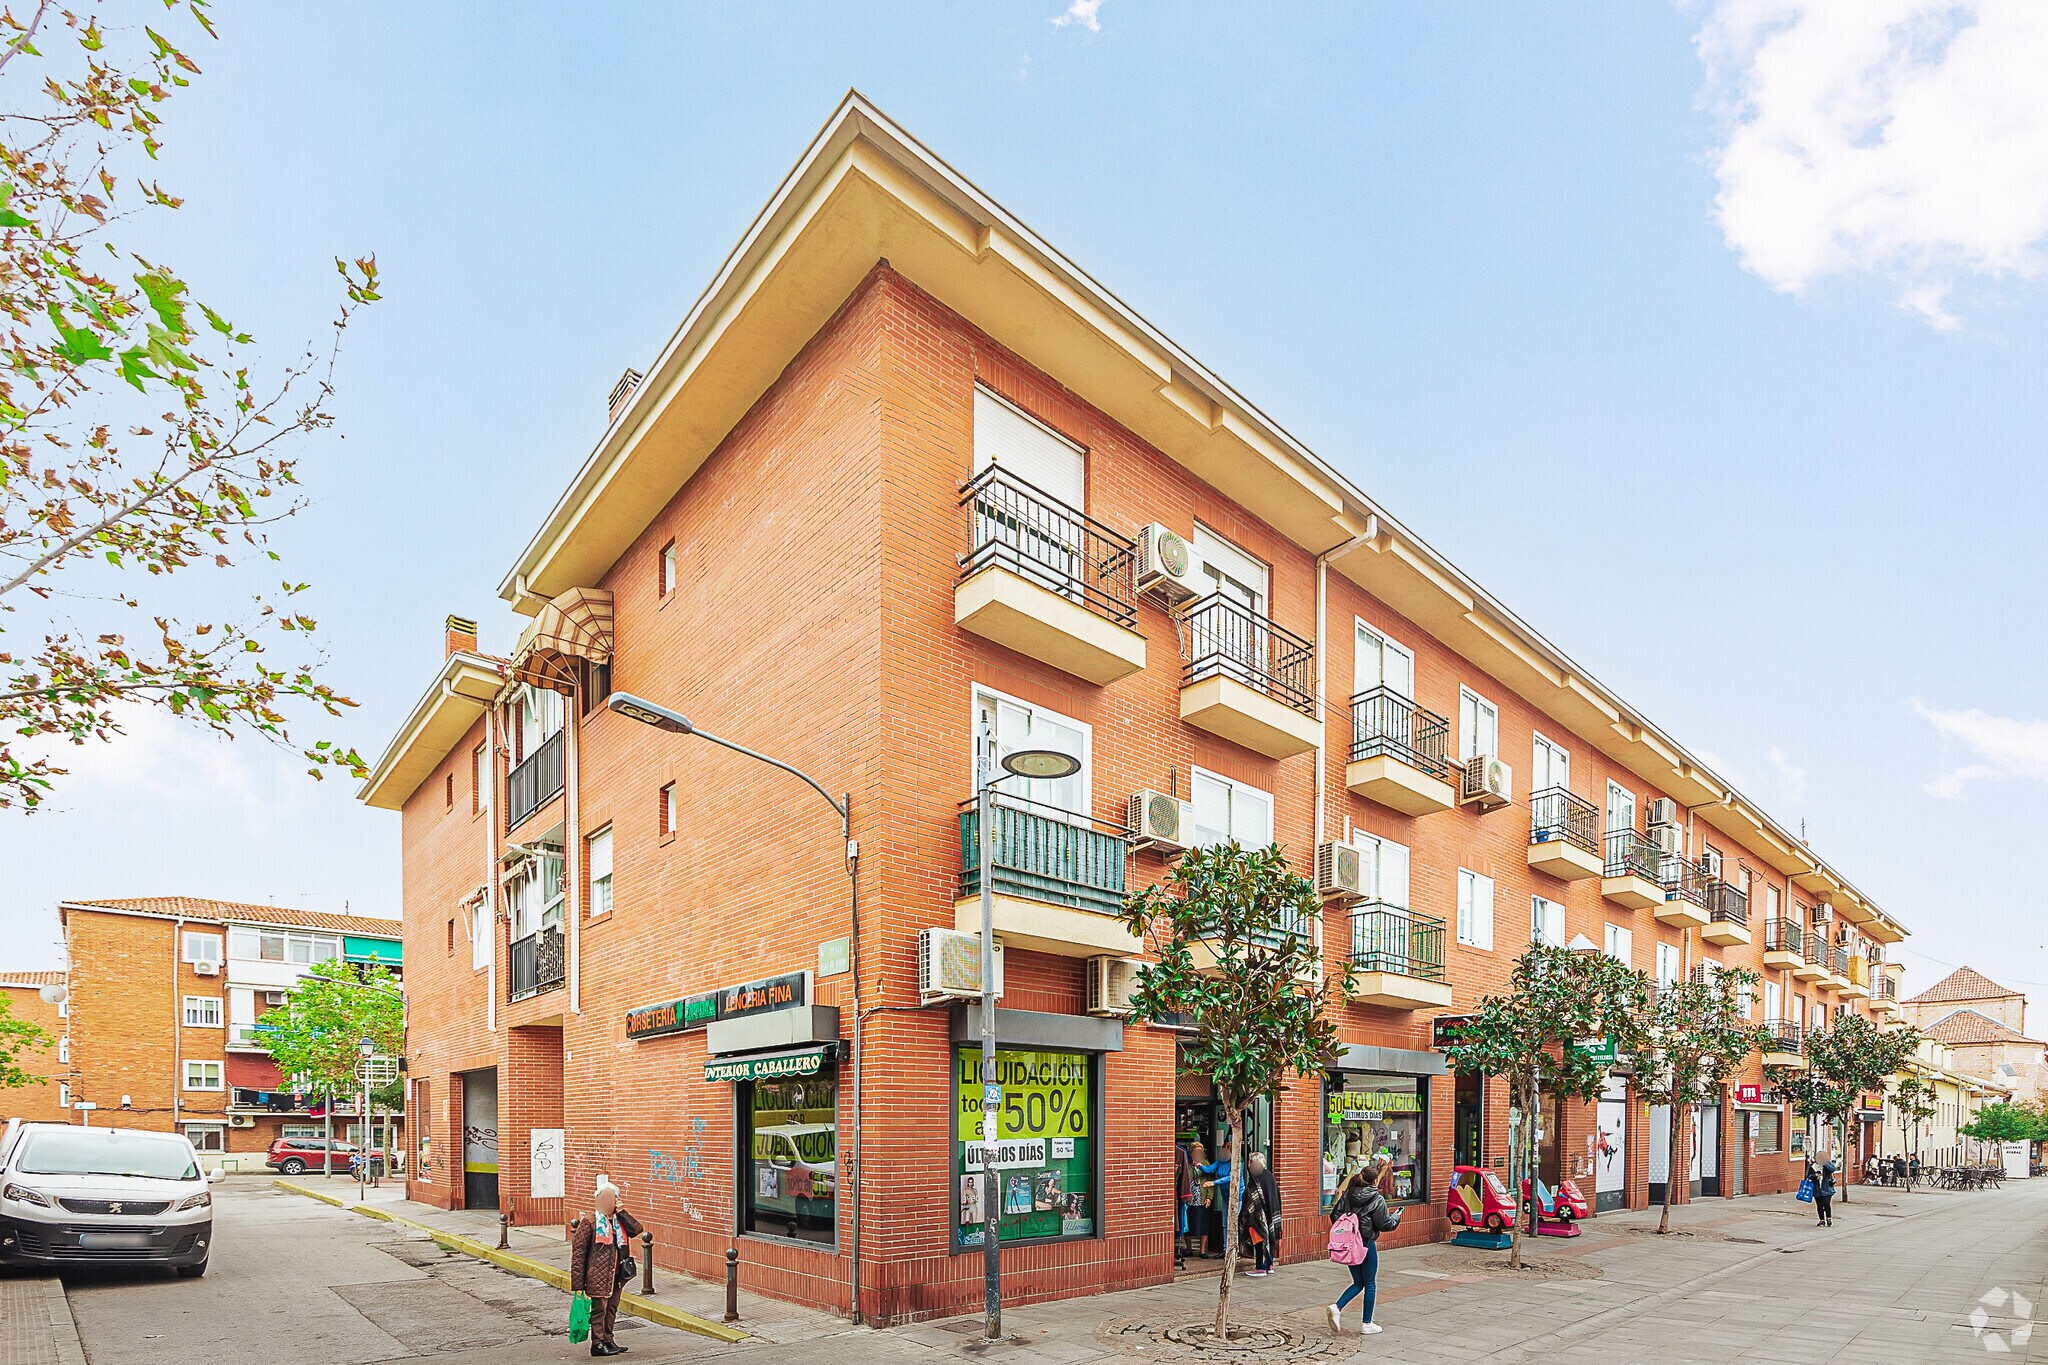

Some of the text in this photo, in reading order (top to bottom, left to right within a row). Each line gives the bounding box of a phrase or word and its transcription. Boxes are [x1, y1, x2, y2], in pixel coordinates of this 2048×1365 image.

[724, 990, 766, 1013] LENCERIA
[768, 984, 792, 1005] FINA
[626, 1007, 677, 1033] CORSETERIA
[705, 1055, 820, 1079] INTERIOR CABALLERO
[961, 1057, 1084, 1087] LIUIDACIÓN
[1004, 1088, 1084, 1134] 50%
[1018, 1142, 1044, 1162] DÍAS
